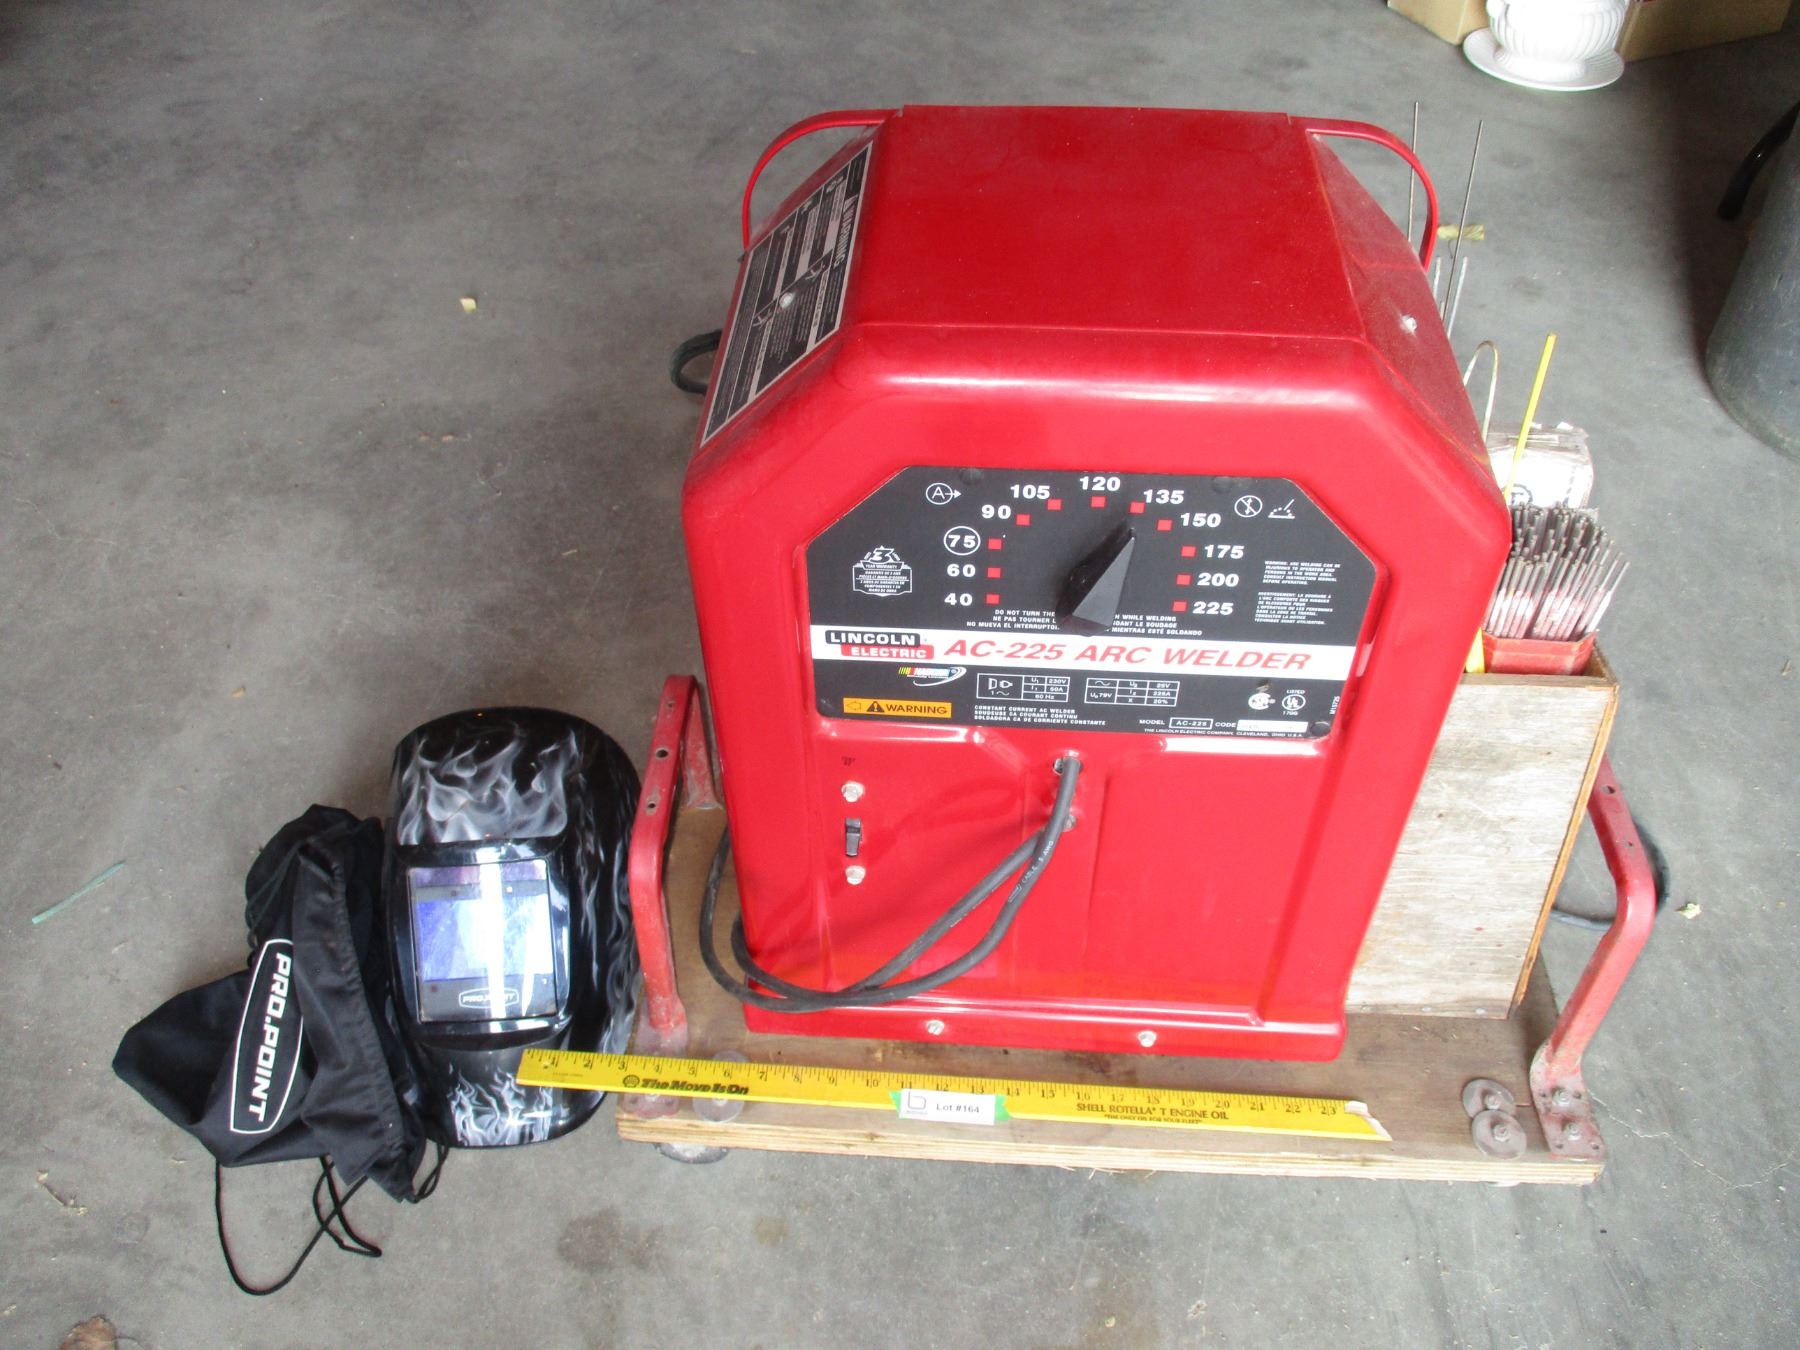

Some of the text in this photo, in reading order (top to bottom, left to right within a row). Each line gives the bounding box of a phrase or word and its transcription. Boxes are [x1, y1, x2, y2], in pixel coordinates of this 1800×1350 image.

[1079, 476, 1121, 491] 120
[1010, 484, 1050, 499] 105
[1143, 489, 1185, 504] 135
[981, 504, 1011, 519] 90
[1180, 512, 1222, 528] 150
[948, 534, 976, 548] 75
[1204, 544, 1245, 559] 175
[946, 563, 976, 578] 60
[1196, 572, 1239, 587] 200
[944, 593, 973, 606] 40
[1192, 601, 1235, 616] 225
[830, 631, 916, 646] LINCOLN
[850, 647, 928, 659] ELECTRIC
[943, 639, 1312, 670] AC-225 ARC WELDER
[885, 704, 948, 715] WARNING
[248, 952, 292, 1122] PRO.POINT
[641, 1078, 750, 1096] The Move Is On
[865, 1079, 879, 1088] 10
[1006, 1087, 1020, 1096] 14
[1041, 1089, 1056, 1099] 15
[1111, 1093, 1125, 1102] 17
[1215, 1100, 1230, 1109] 20
[1250, 1102, 1264, 1111] 21
[1285, 1104, 1301, 1113] 22
[1321, 1106, 1337, 1115] 23
[936, 1103, 980, 1114] Lot #164
[1076, 1103, 1106, 1113] SHELL
[1160, 1107, 1167, 1115] T
[1170, 1108, 1209, 1119] ENGINE
[1211, 1111, 1229, 1120] OIL
